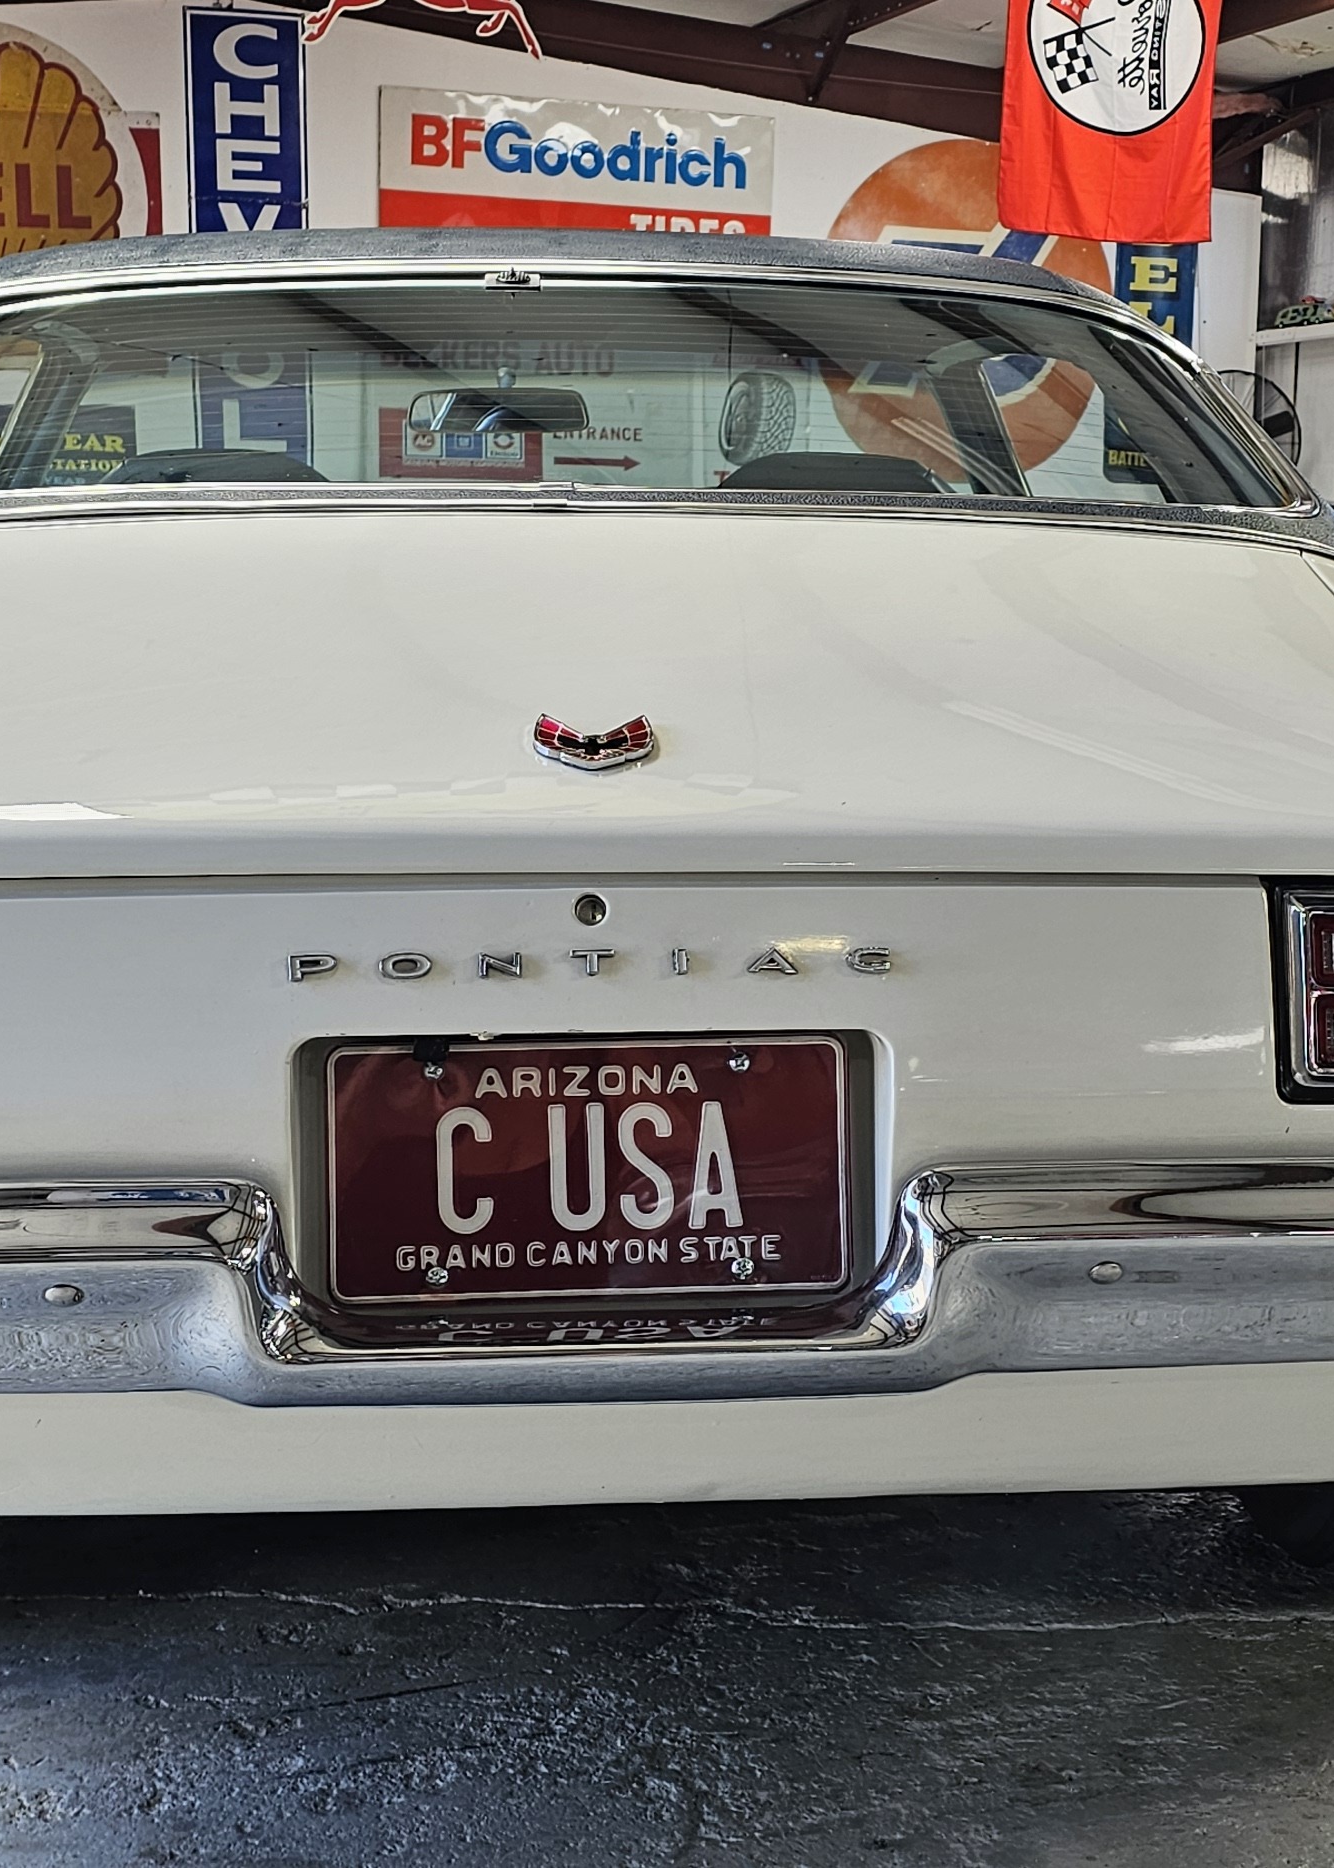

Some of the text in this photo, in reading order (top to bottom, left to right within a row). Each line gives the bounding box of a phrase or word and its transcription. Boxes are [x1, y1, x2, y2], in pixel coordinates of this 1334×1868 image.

[410, 113, 748, 190] BFGoodrich
[535, 341, 616, 377] AUTO
[63, 432, 126, 454] EAR
[287, 945, 893, 983] PONTIAC
[474, 1062, 699, 1099] ARIZONA
[435, 1101, 745, 1235] C USA
[395, 1234, 782, 1273] GRAND CANYON STATE
